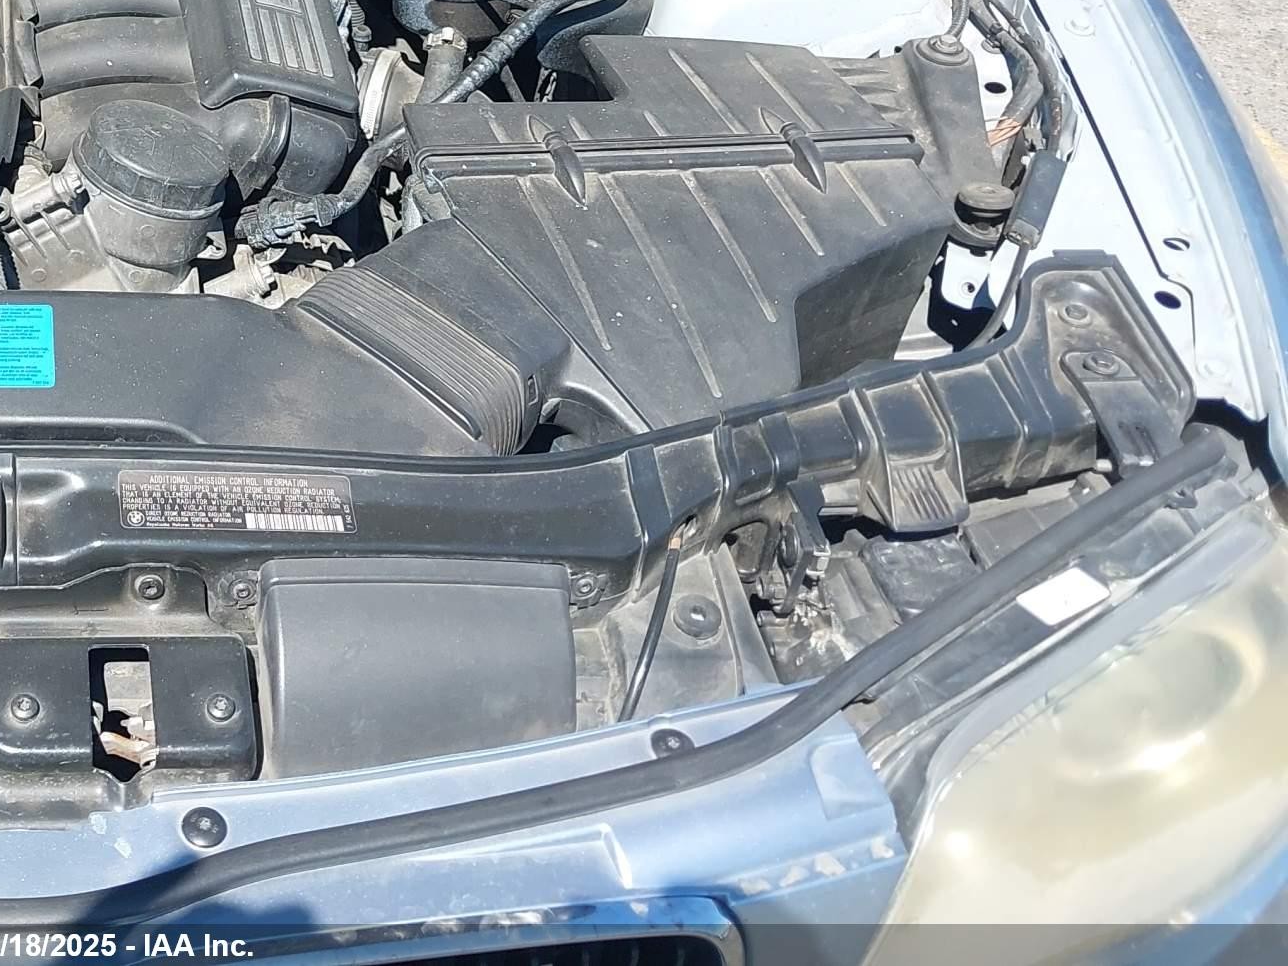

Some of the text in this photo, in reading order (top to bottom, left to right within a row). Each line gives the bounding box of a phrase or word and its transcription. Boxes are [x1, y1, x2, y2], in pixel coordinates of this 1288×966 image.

[150, 475, 308, 487] ADDITIONAL EMISSION CONTROL INFORMATION
[213, 485, 229, 493] WITH
[267, 487, 301, 495] REDUCTION
[304, 488, 335, 496] RADIATOR
[242, 500, 281, 508] EQUIVALENT
[307, 502, 341, 510] REDUCTION
[247, 506, 281, 514] POLLUTION
